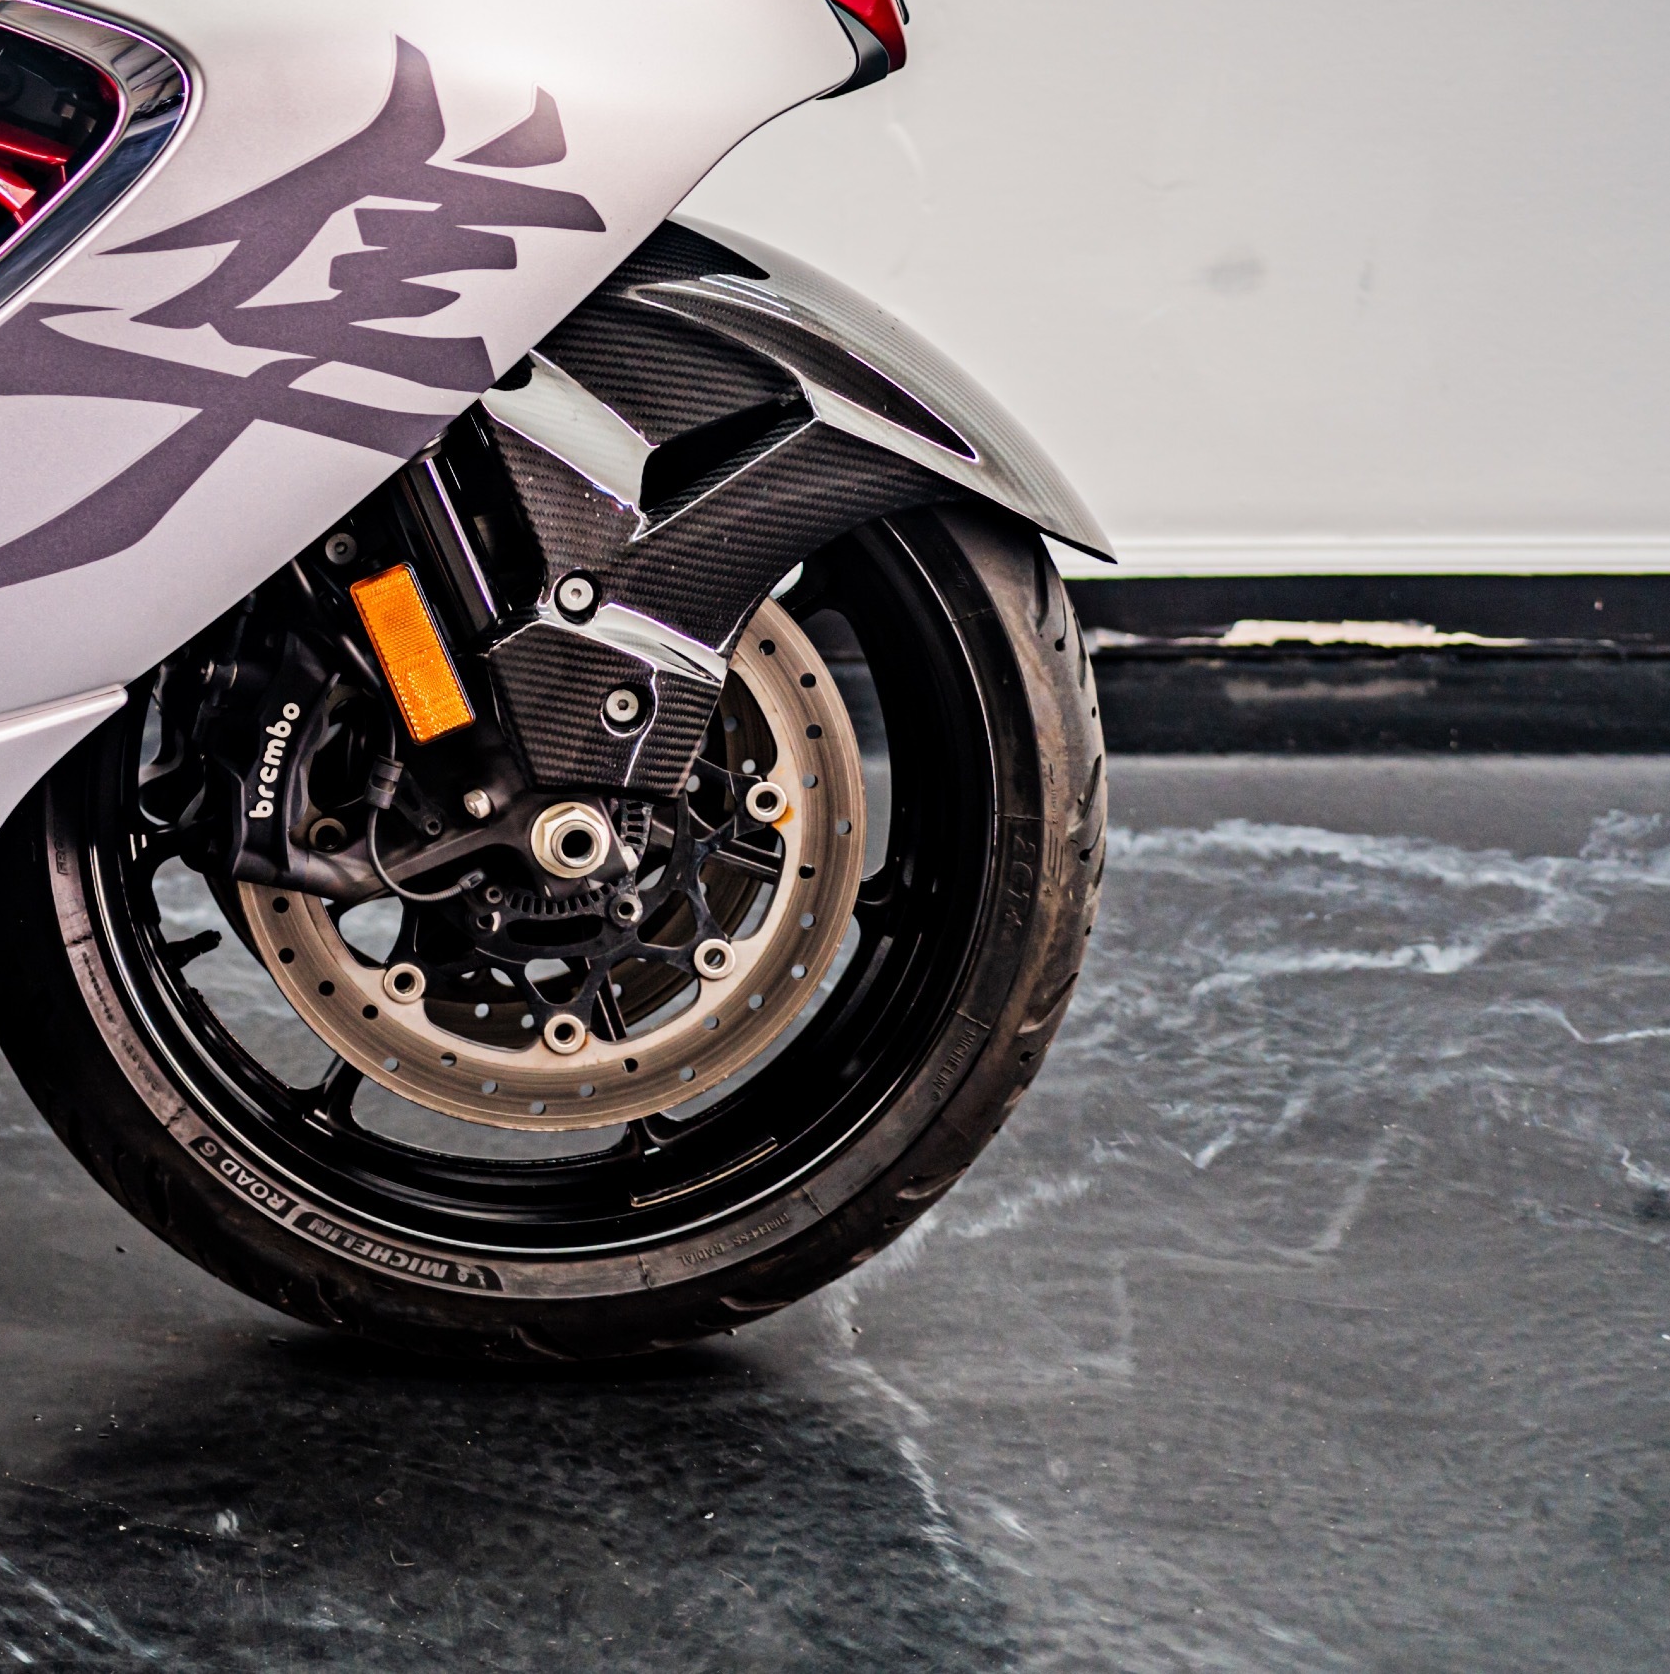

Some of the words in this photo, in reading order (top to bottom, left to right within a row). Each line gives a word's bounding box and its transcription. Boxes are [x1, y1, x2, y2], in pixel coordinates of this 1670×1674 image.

[249, 702, 300, 818] brembo
[932, 1029, 977, 1091] MICHELIN
[198, 1141, 218, 1158] 6
[219, 1158, 288, 1211] ROAD
[307, 1217, 449, 1280] MICHELIN
